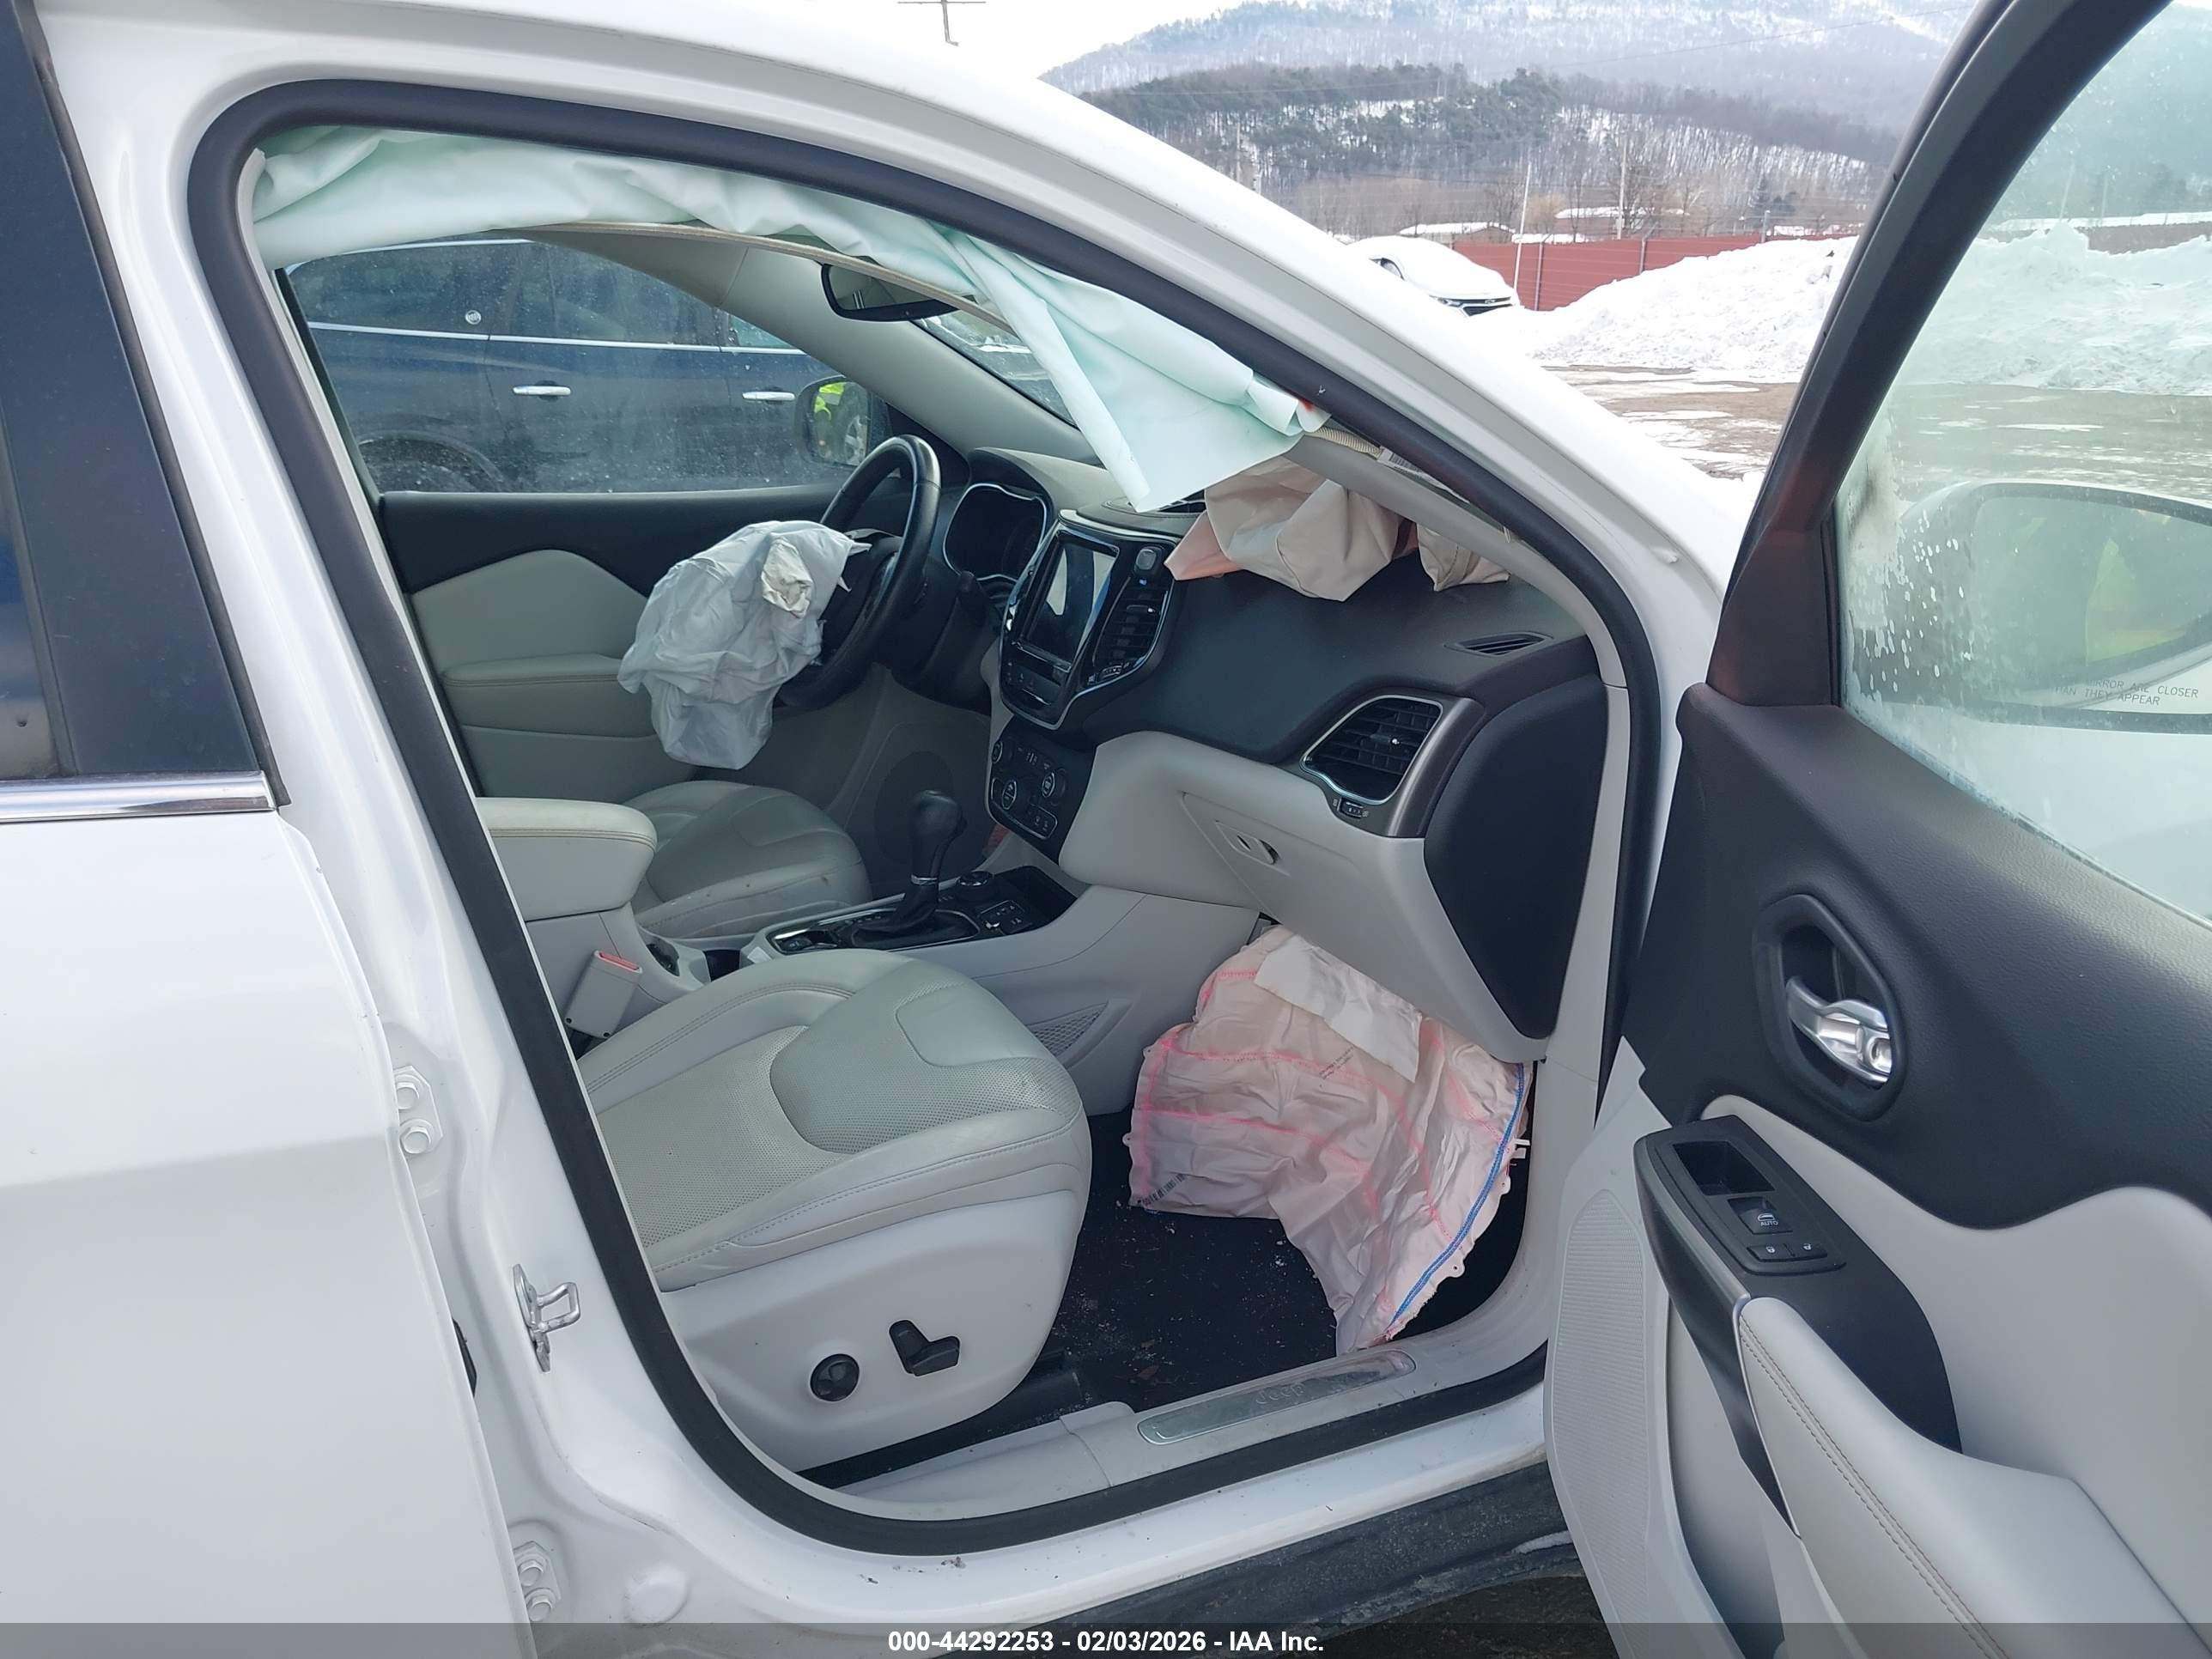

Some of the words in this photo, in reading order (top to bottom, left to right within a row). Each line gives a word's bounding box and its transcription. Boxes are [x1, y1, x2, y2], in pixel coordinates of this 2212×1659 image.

[2085, 688, 2112, 700] THEY
[2118, 693, 2160, 706] APPEAR
[2157, 685, 2199, 698] CLOSER
[1255, 1382, 1306, 1405] Jeep
